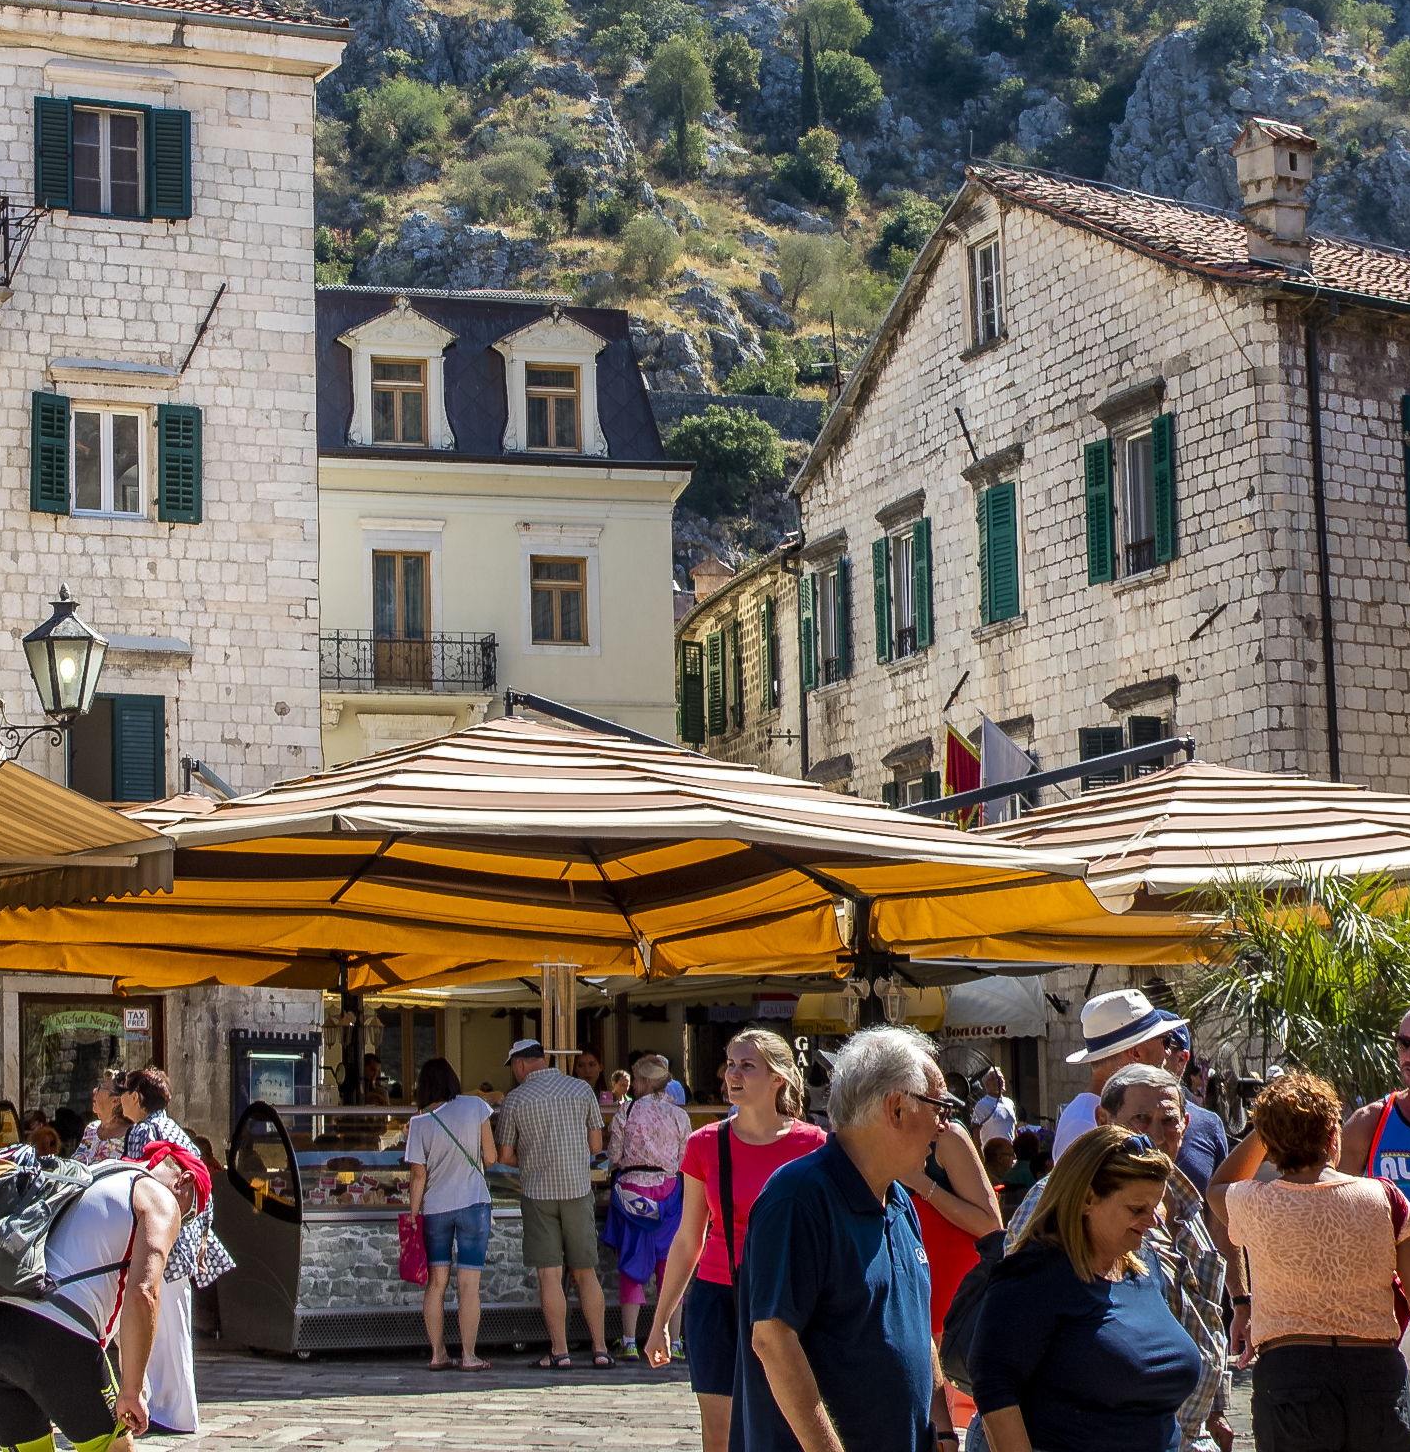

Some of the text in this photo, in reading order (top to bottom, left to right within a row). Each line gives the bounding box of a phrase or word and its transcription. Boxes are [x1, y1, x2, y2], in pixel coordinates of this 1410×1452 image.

[55, 1012, 87, 1026] Michal
[127, 1011, 145, 1020] TAX
[817, 1022, 837, 1032] Post
[945, 1025, 1007, 1038] Bonaca
